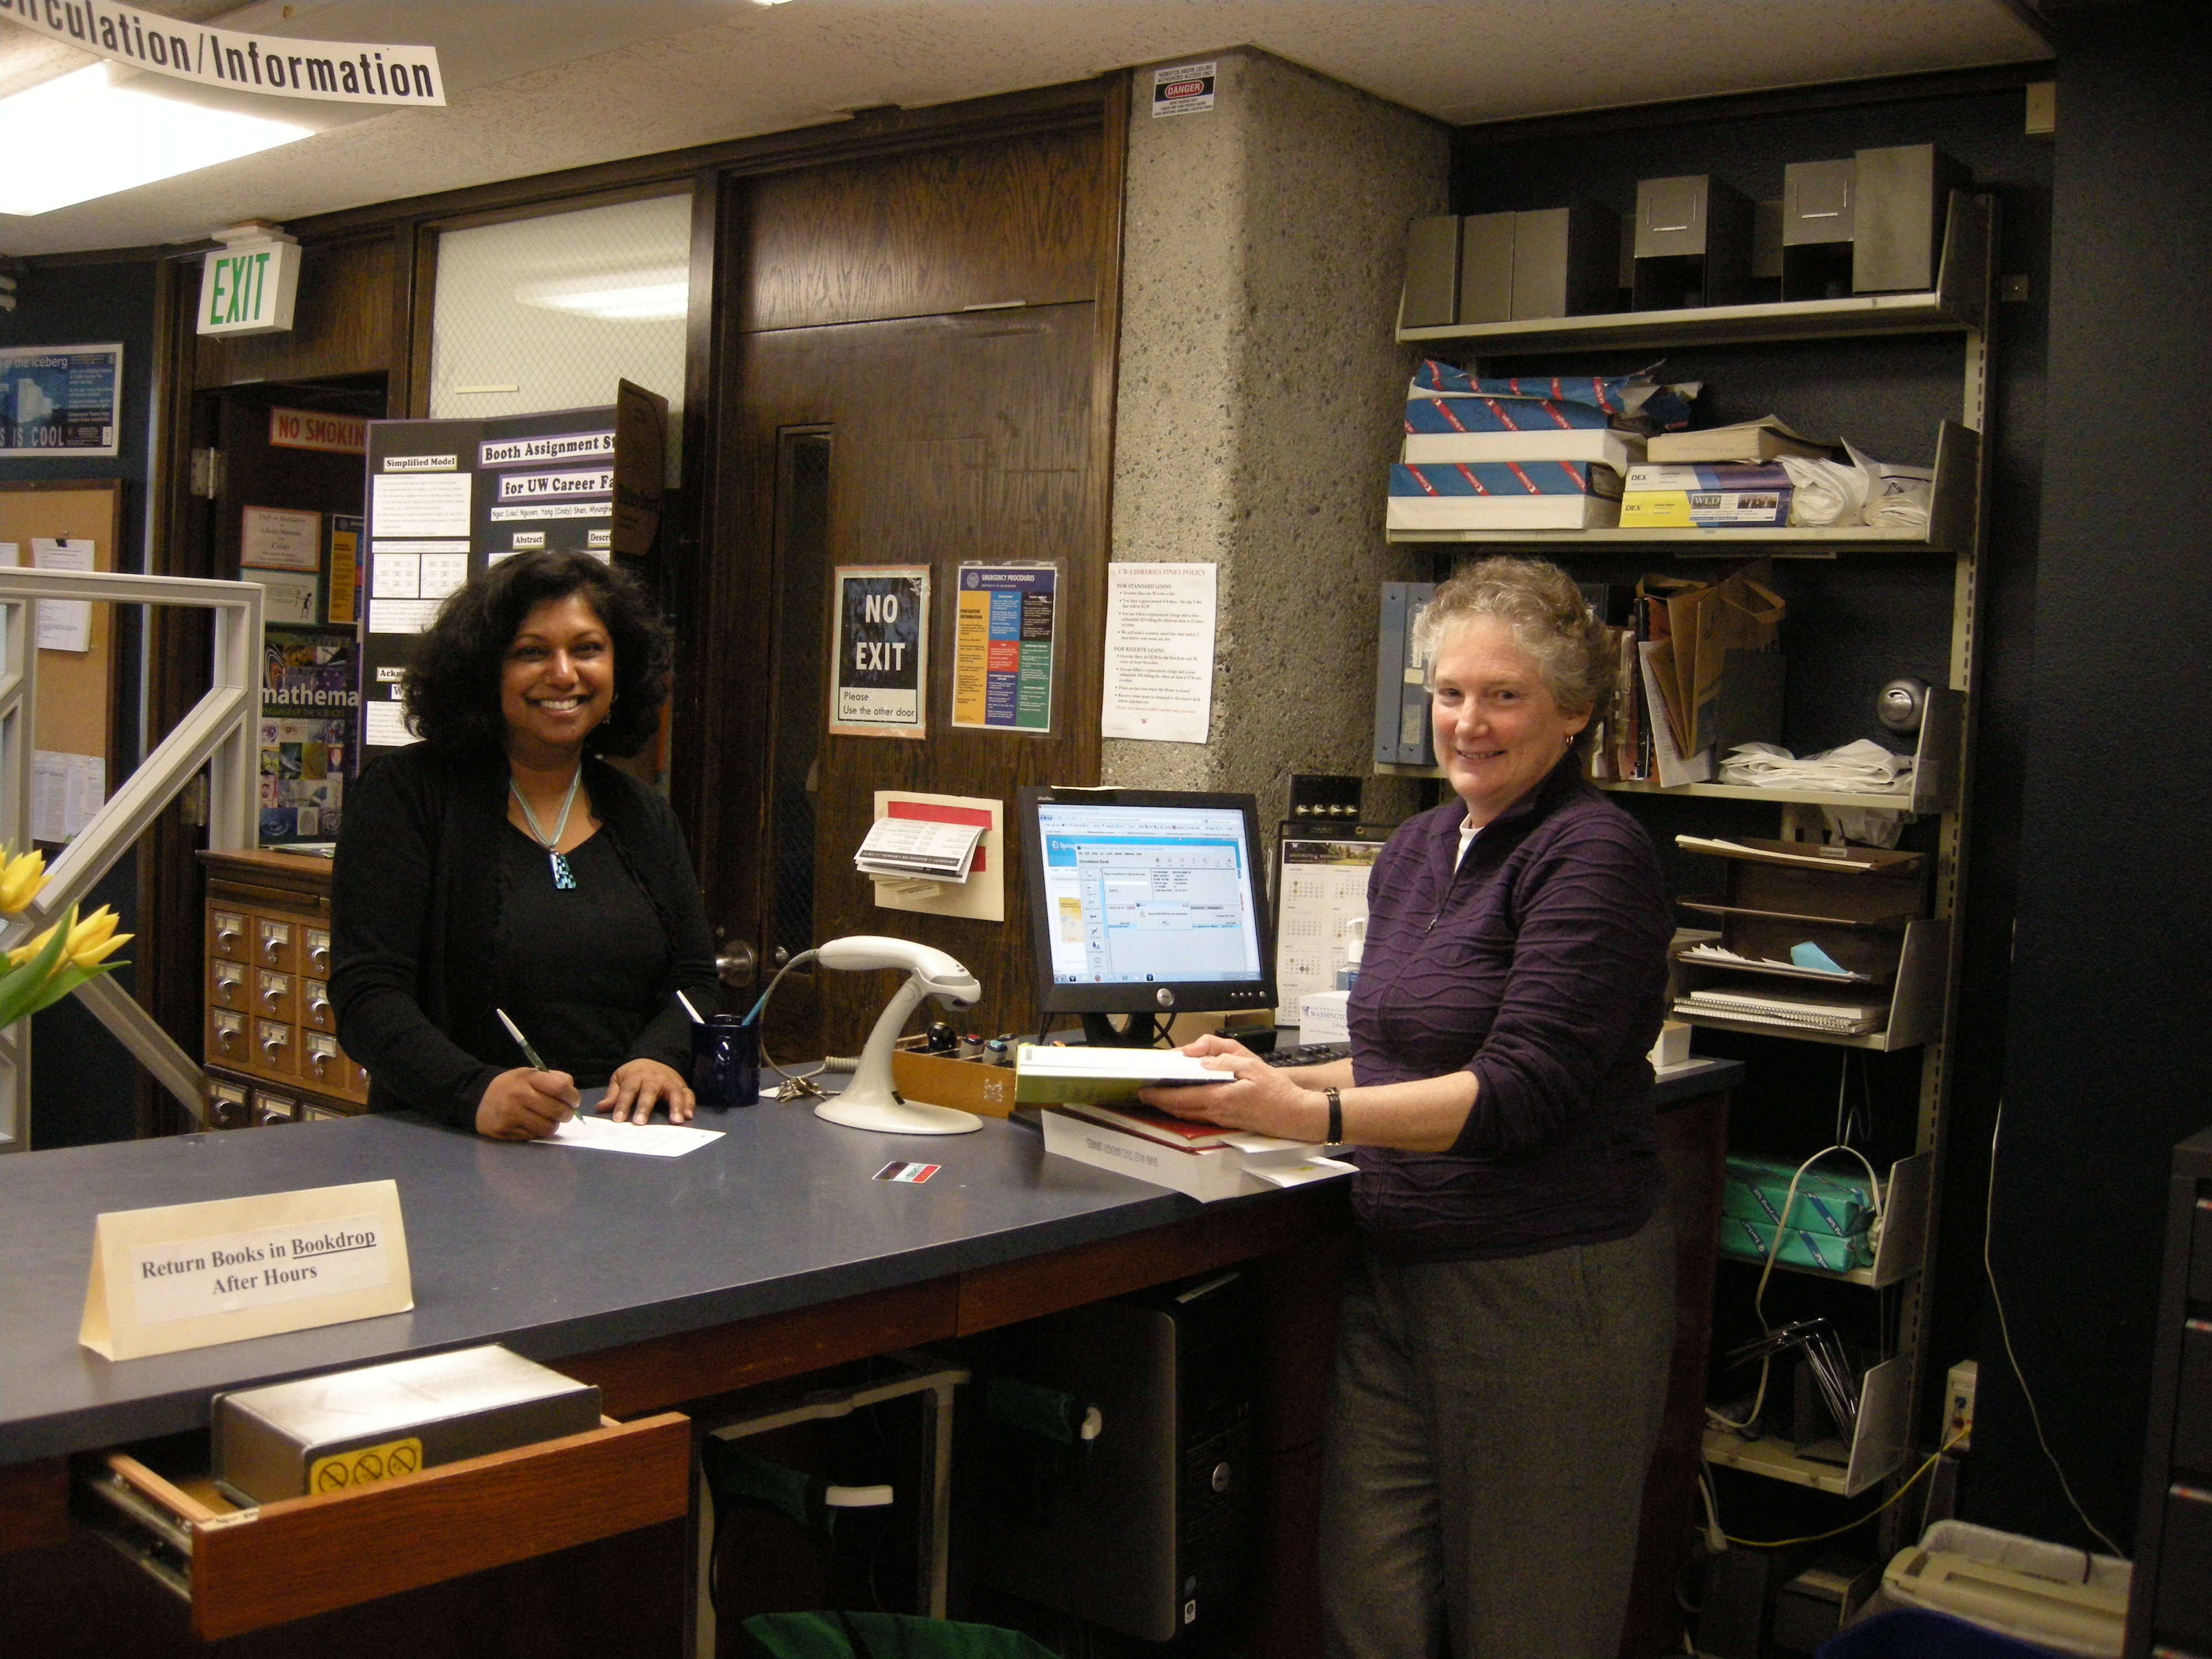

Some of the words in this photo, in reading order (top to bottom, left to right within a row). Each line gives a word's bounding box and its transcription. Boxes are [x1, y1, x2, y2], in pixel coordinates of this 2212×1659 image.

[0, 0, 434, 97] culation/Information
[1168, 84, 1201, 95] DANGER
[210, 253, 270, 325] EXIT
[15, 358, 28, 367] the
[279, 416, 300, 439] NO
[1556, 415, 1568, 429] Bright
[13, 426, 23, 447] IS
[32, 426, 64, 447] COOL
[486, 445, 520, 461] Booth
[525, 437, 599, 457] Assignment
[387, 458, 429, 468] Simplified
[505, 482, 523, 495] for
[528, 478, 549, 492] UW
[552, 478, 595, 491] Career
[1415, 471, 1429, 488] Eclipse
[1466, 471, 1480, 488] Eclipse
[1519, 472, 1532, 489] Eclipse
[1695, 496, 1720, 504] WLD
[493, 511, 504, 519] Ngoc
[520, 509, 539, 518] Nguyen,
[541, 508, 553, 517] Yang
[555, 507, 572, 516] (Cindy)
[515, 535, 542, 543] Abstract
[865, 594, 898, 623] NO
[856, 642, 905, 671] EXIT
[262, 684, 359, 706] mathema
[844, 691, 869, 701] Please
[843, 706, 858, 715] Use
[859, 707, 872, 716] the
[874, 707, 895, 717] other
[896, 707, 915, 717] door
[1311, 1011, 1348, 1020] WASHINGTO
[1827, 1217, 1835, 1229] 30%
[141, 1256, 206, 1280] Return
[211, 1246, 265, 1269] Books
[269, 1243, 286, 1259] in
[291, 1229, 377, 1256] Bookdrop
[213, 1273, 259, 1296] After
[264, 1265, 317, 1287] Hours
